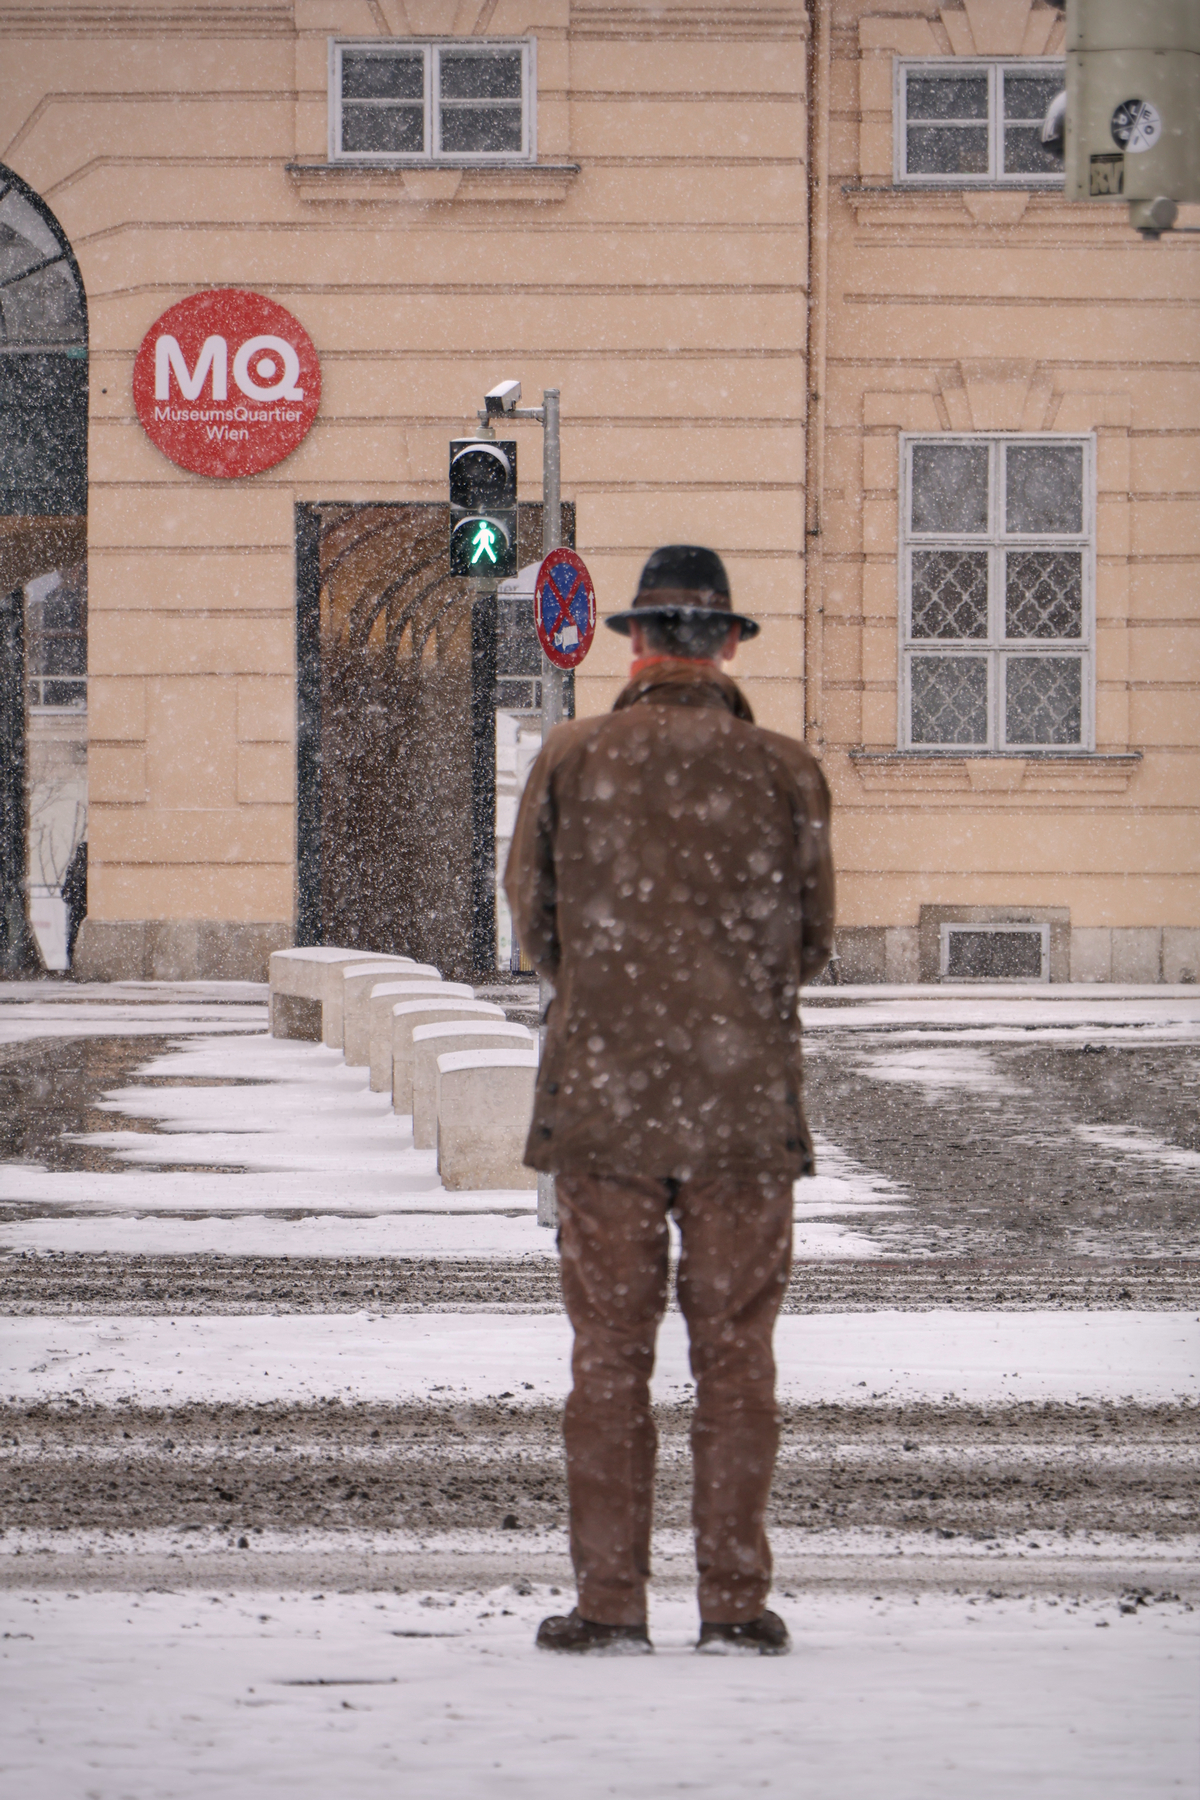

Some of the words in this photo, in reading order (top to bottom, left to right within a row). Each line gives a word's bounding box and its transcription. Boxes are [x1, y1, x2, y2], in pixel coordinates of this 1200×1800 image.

[155, 334, 303, 401] MQ
[154, 406, 302, 422] MuseumsQuartier
[206, 425, 249, 440] Wien
